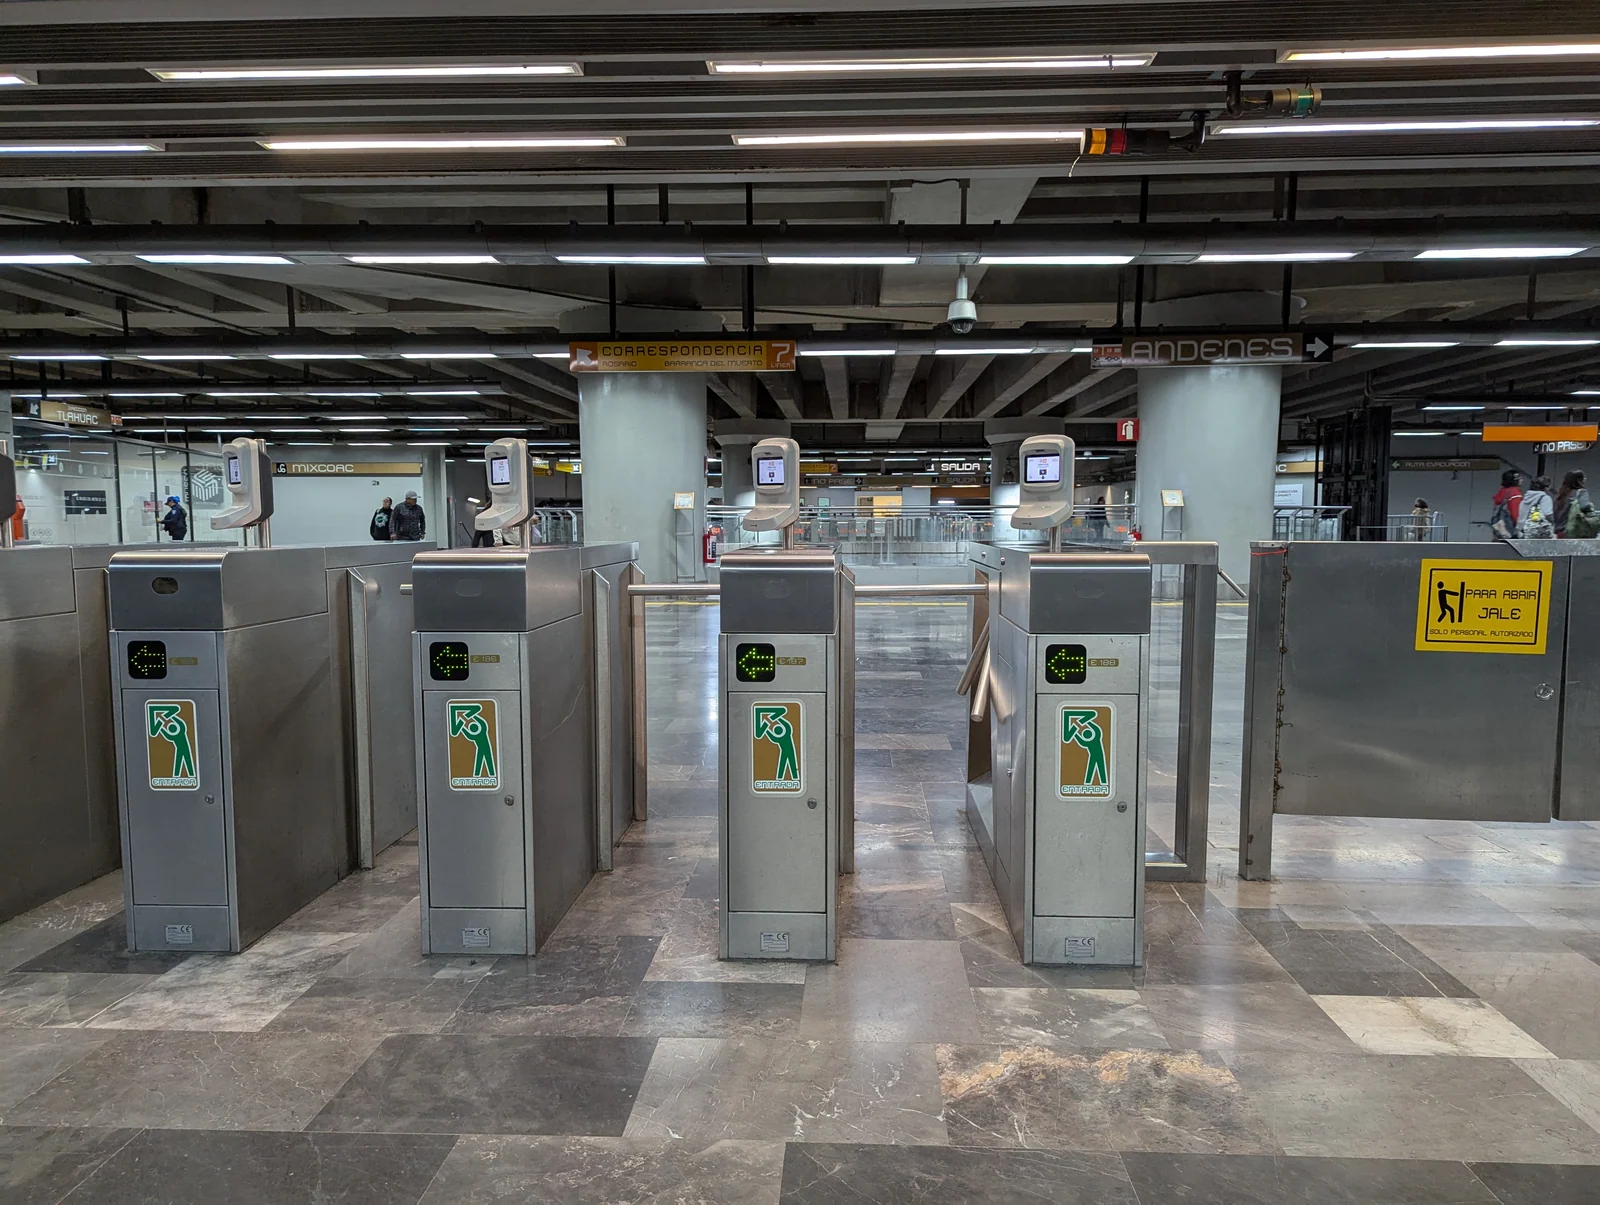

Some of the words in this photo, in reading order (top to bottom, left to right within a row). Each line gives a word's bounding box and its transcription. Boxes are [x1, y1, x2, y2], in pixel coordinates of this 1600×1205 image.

[602, 345, 763, 357] CORRESPONDENCIA
[771, 343, 791, 363] 7
[1130, 338, 1293, 362] ANDENES
[1541, 442, 1555, 453] NO
[292, 463, 354, 473] MIXCOAC
[941, 463, 981, 471] SALIDA
[1465, 589, 1497, 600] PARA
[1502, 590, 1537, 601] ABRIR
[1477, 607, 1522, 620] JALE
[1429, 628, 1449, 636] SOLO
[1450, 629, 1488, 637] PERSONAL
[1489, 630, 1534, 638] AUTORIZADO
[152, 778, 197, 787] ENTRADA
[452, 778, 497, 786] ENTRADA
[755, 780, 800, 789] ENTRADA
[1062, 785, 1109, 794] ENTRADA
